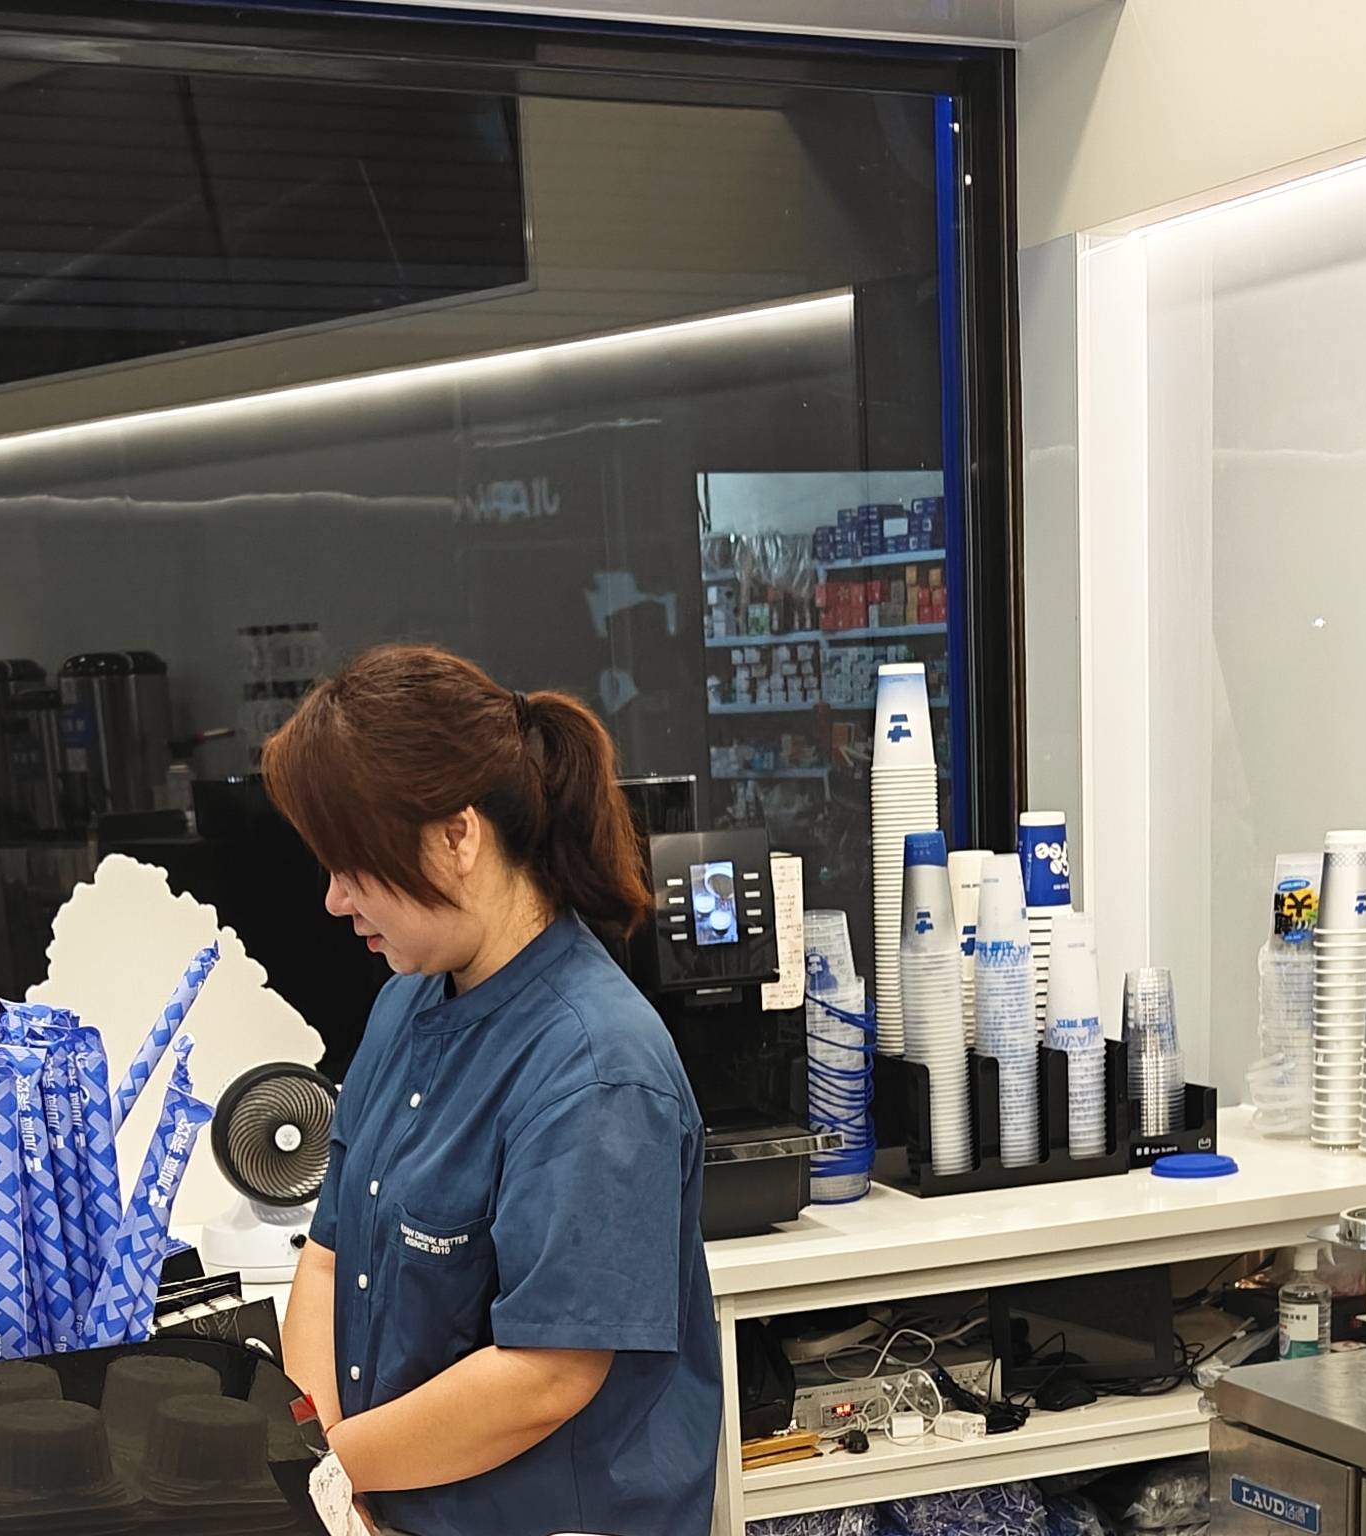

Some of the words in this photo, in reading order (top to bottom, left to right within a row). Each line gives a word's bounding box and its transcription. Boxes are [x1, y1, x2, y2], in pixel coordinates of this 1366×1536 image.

[156, 1153, 181, 1191] 加减
[169, 1117, 196, 1156] 茶饮
[430, 1244, 451, 1256] 2010
[438, 1233, 470, 1247] BETTER
[1241, 1486, 1285, 1517] LAUD
